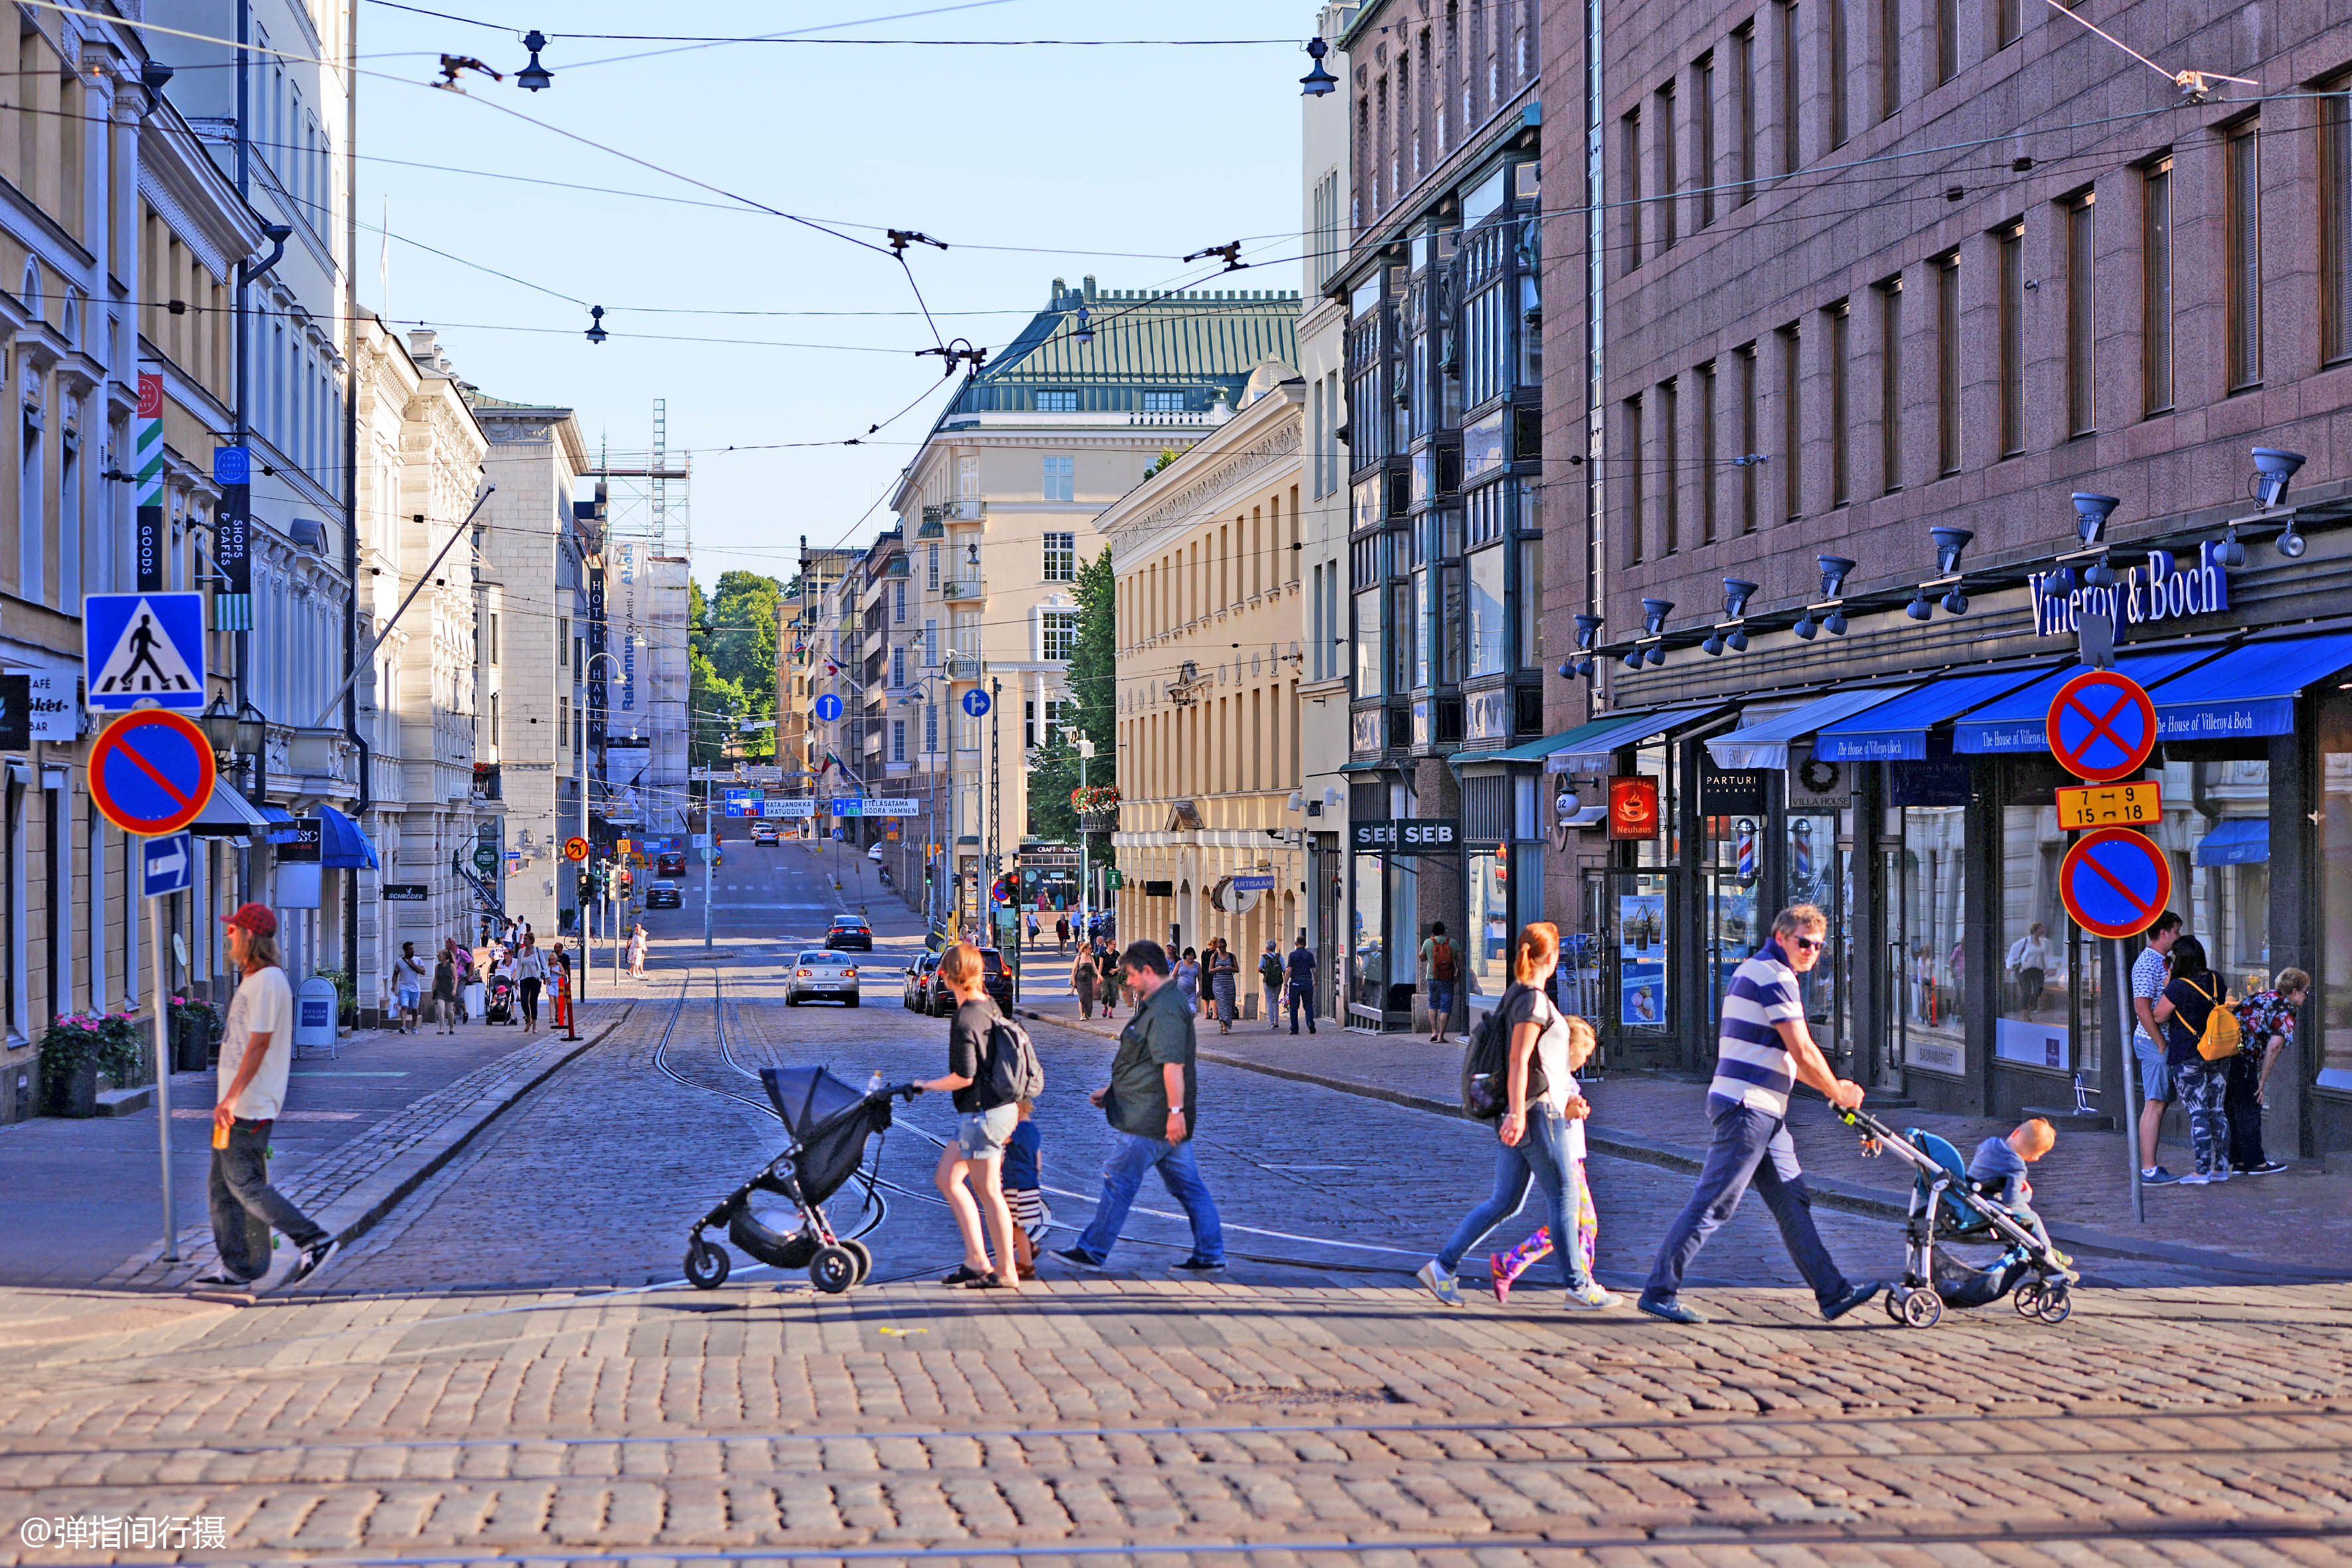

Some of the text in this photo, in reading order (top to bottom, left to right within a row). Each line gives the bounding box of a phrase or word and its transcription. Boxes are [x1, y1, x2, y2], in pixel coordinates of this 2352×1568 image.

[220, 512, 234, 566] & CAFÉS
[233, 520, 243, 558] SHOPS
[141, 526, 152, 574] GOODS
[2128, 566, 2146, 624] &
[2148, 540, 2219, 620] Boch
[592, 580, 601, 643] HOTEL
[621, 636, 635, 710] Rakennus
[30, 677, 51, 689] AFÉ
[2168, 715, 2189, 732] House
[2191, 713, 2200, 730] of
[2201, 712, 2227, 734] Villeroy
[2234, 711, 2252, 729] Boch
[1838, 742, 1846, 755] The
[1847, 742, 1863, 755] House
[1890, 740, 1902, 754] Boch
[1982, 732, 1993, 747] The
[1994, 731, 2011, 746] House
[2013, 730, 2019, 745] of
[2020, 729, 2041, 748] Villeroy
[1610, 781, 1636, 791] Chocolat
[1707, 776, 1757, 785] PARTURI
[1557, 799, 1567, 809] 32
[1793, 797, 1849, 805] VILLA HOUSE
[2081, 791, 2088, 805] 7
[2125, 787, 2134, 802] 9
[2077, 808, 2094, 824] 15
[2124, 805, 2143, 821] 18
[1617, 825, 1652, 834] Neuhaus
[1235, 879, 1274, 888] ARTISAANI
[1919, 1048, 1953, 1066] SAUNAMARKET
